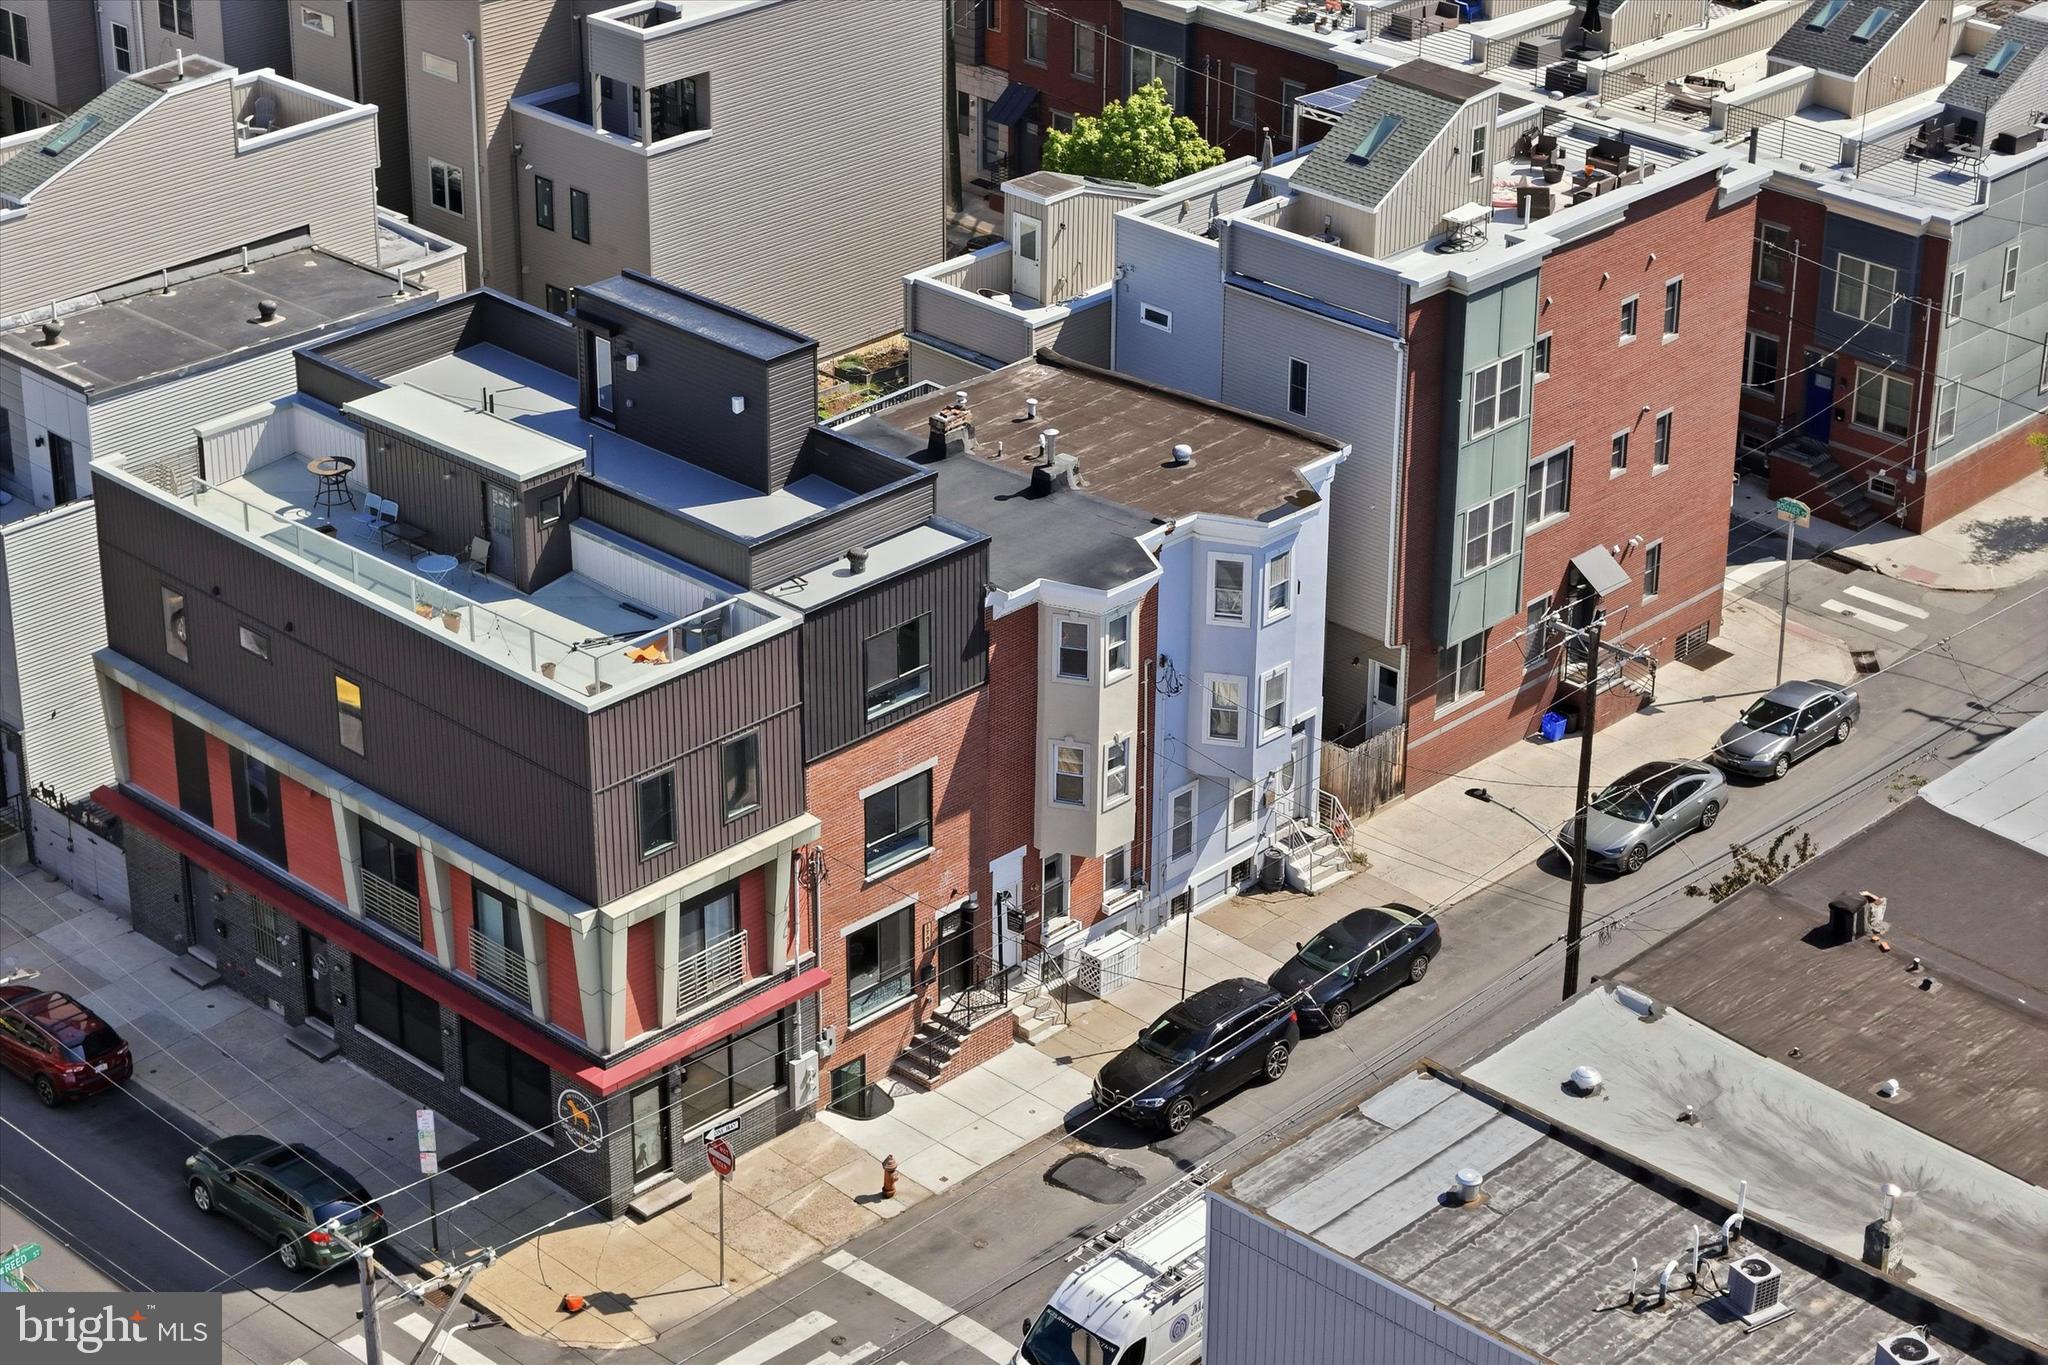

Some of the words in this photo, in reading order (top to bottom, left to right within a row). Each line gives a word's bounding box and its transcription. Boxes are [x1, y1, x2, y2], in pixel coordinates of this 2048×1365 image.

[725, 1122, 737, 1131] WAY
[4, 1254, 27, 1273] REED
[32, 1249, 40, 1258] ST
